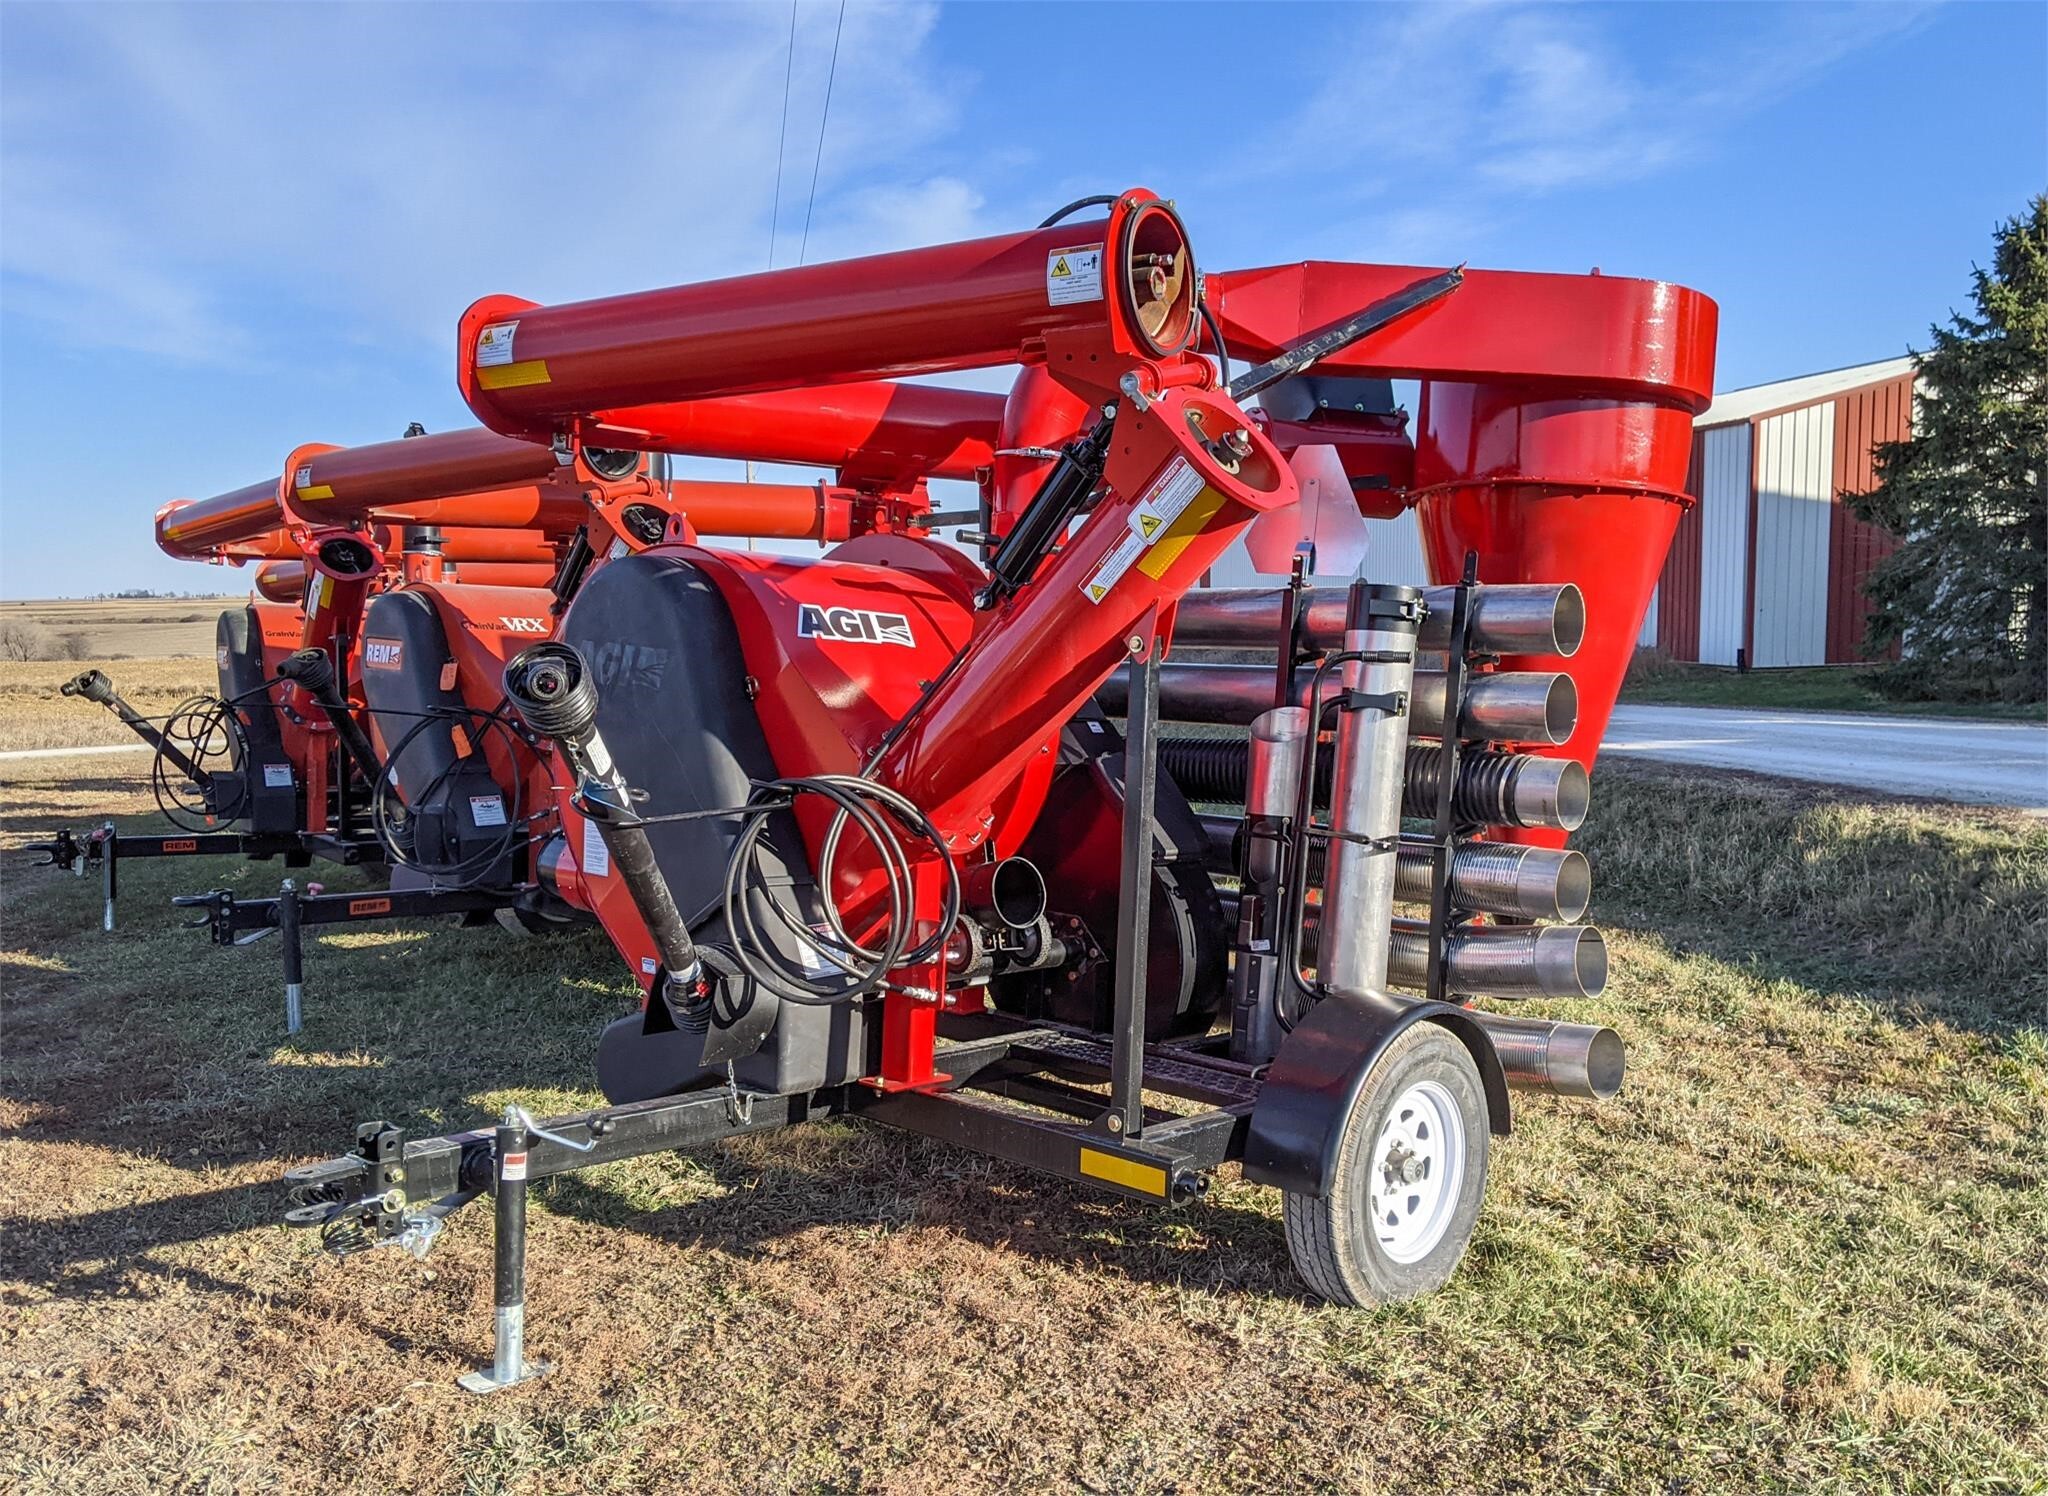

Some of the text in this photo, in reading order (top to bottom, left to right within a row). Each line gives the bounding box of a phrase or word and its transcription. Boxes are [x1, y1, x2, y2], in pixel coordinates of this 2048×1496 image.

[1159, 463, 1180, 488] DANGER
[499, 616, 548, 632] VRX
[799, 605, 879, 641] AGI
[366, 643, 391, 664] REM
